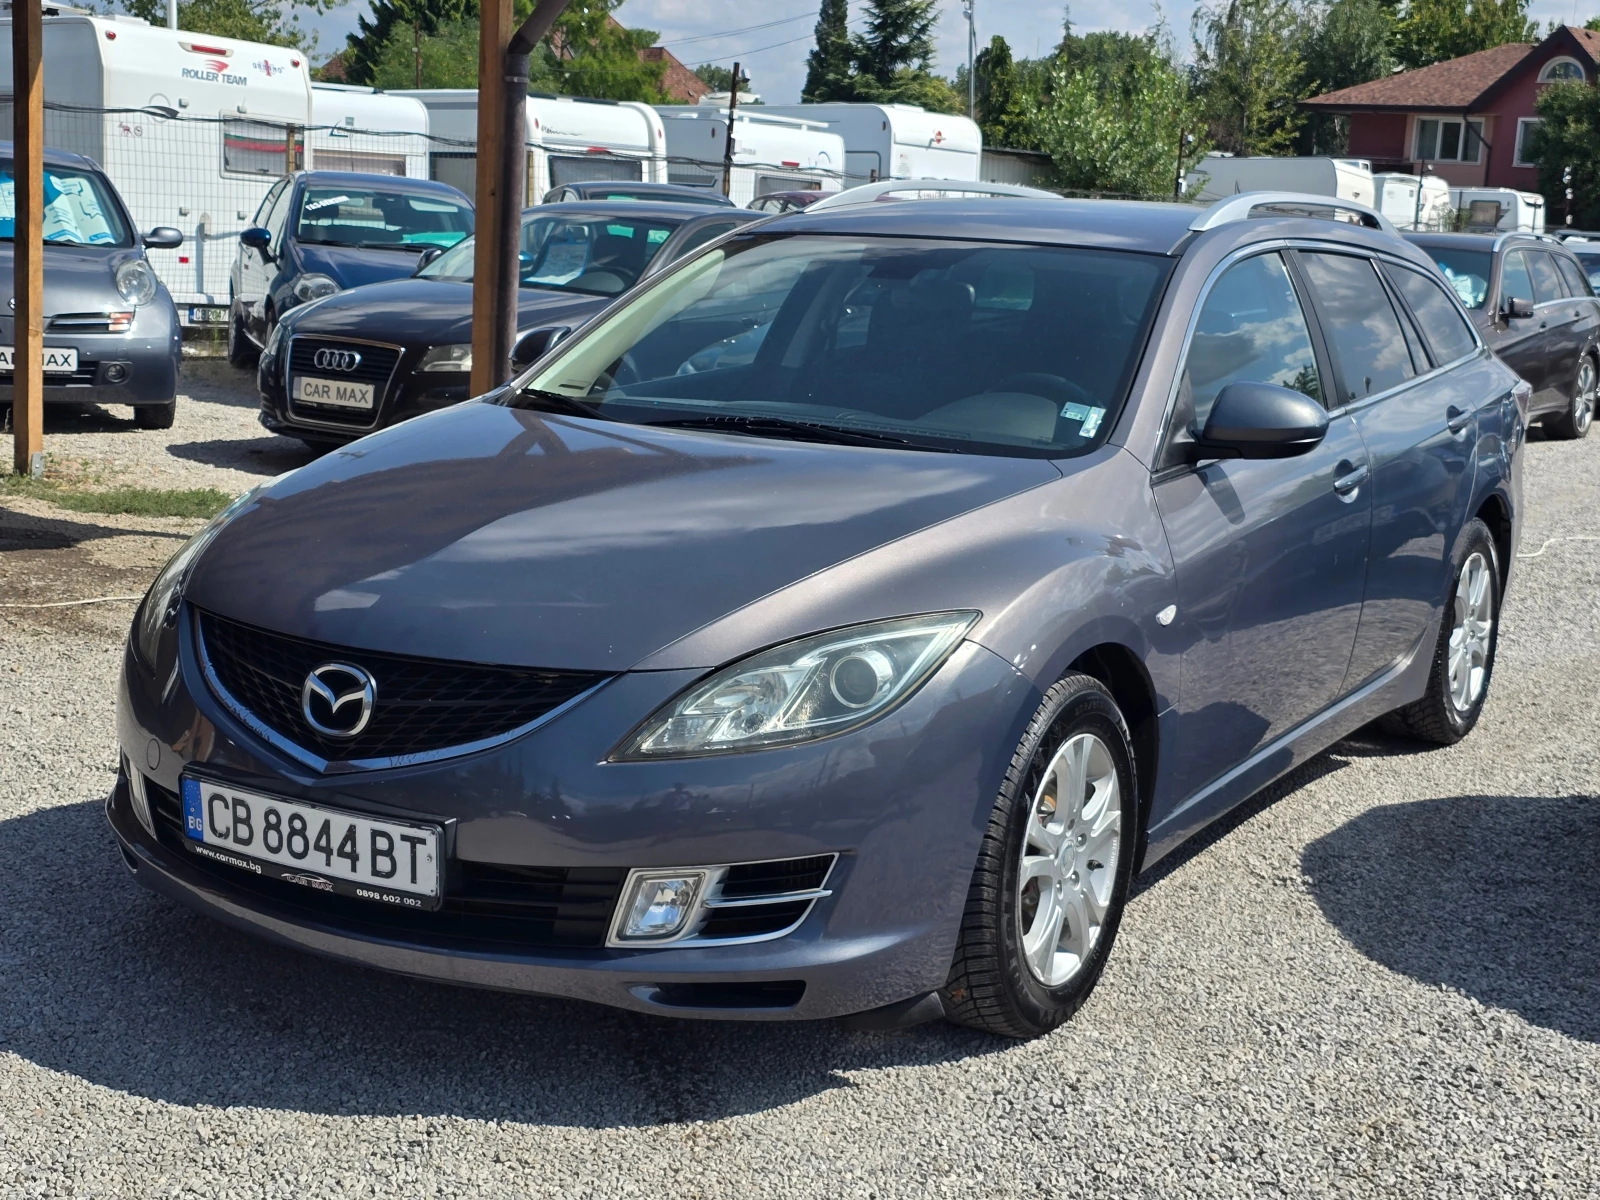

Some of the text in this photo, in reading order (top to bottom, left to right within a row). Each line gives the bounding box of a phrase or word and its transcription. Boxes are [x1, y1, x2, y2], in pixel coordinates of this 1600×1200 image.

[181, 68, 247, 86] ROLLER TEAM
[42, 353, 72, 367] AX
[304, 382, 369, 404] CAR MAX
[187, 815, 203, 831] BG
[207, 792, 427, 885] CB 8844 BT
[195, 845, 262, 874] www.carmax.bg
[356, 888, 422, 908] 0898 602 002
